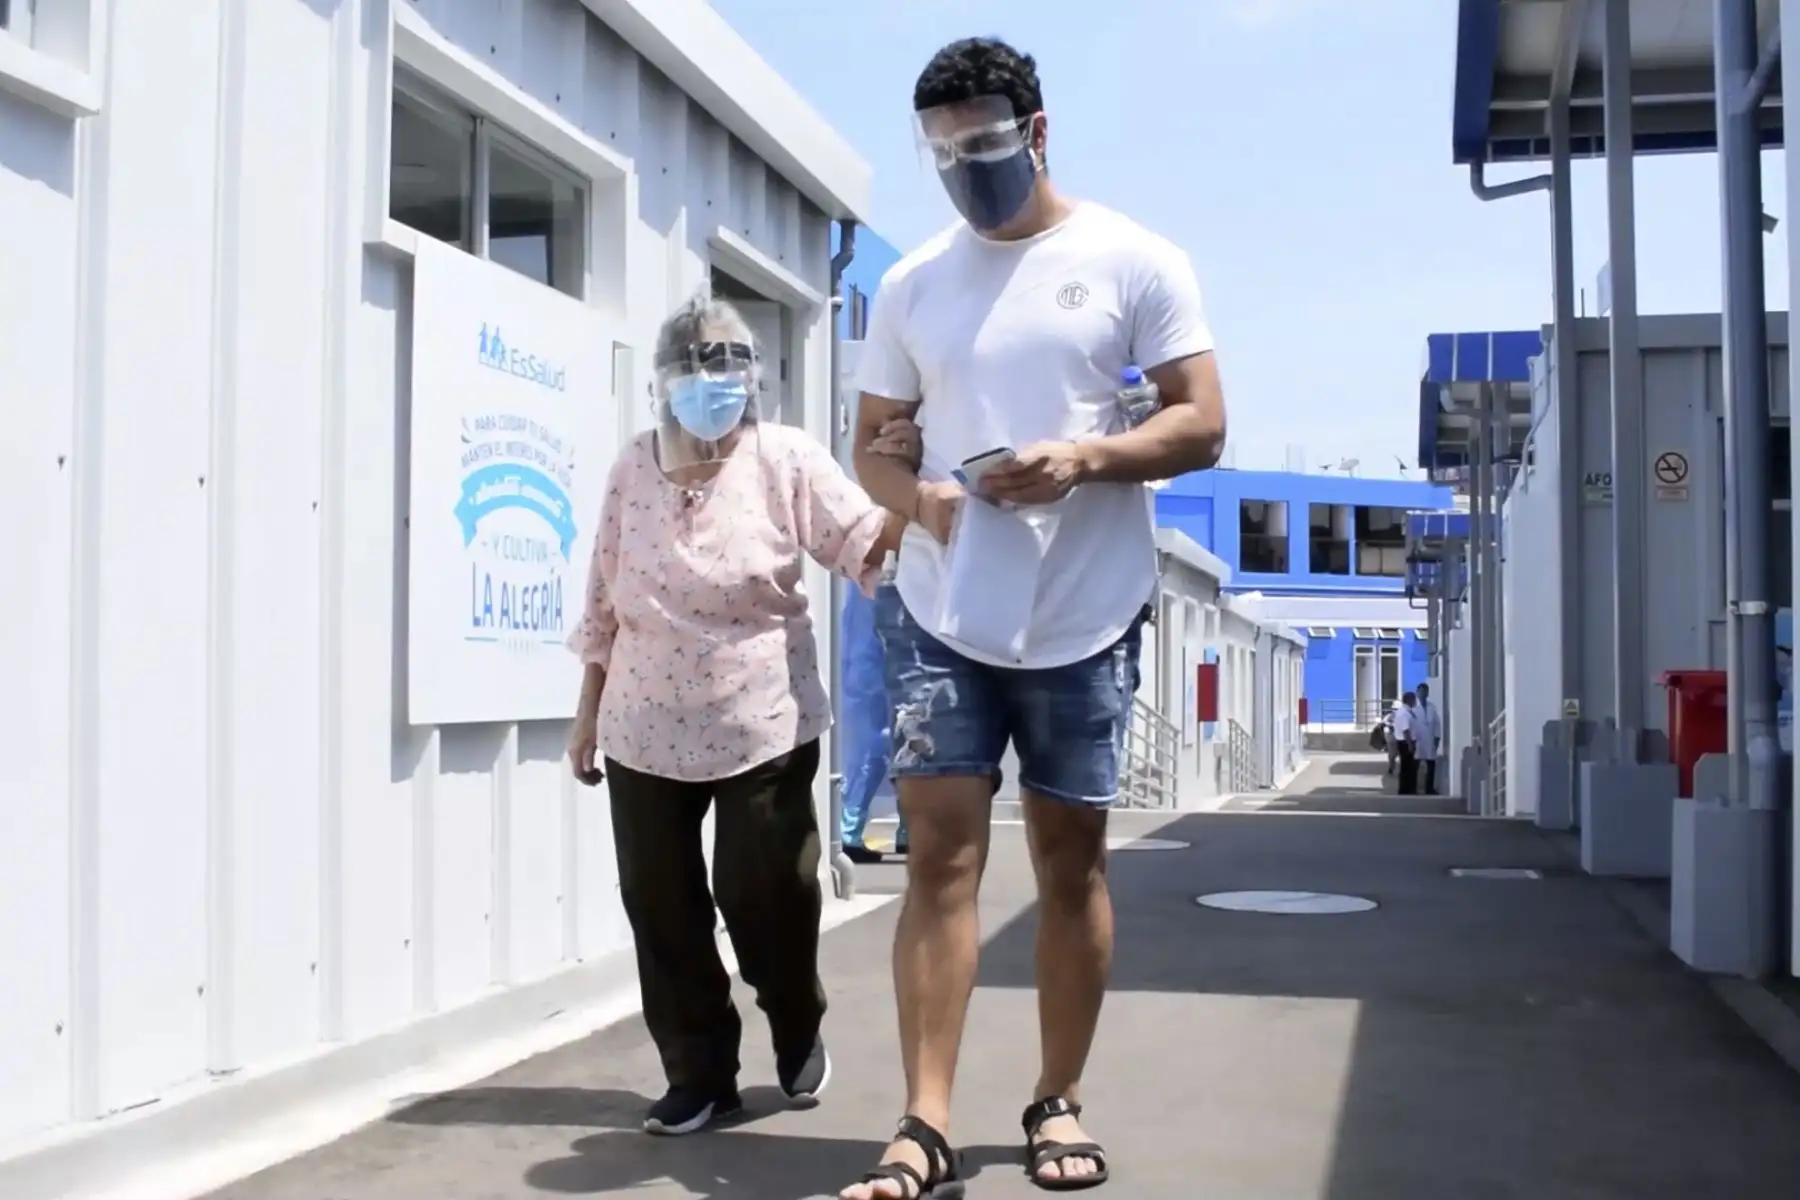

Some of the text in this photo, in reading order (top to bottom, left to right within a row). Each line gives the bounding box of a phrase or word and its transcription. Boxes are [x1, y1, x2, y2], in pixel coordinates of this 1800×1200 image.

[511, 348, 565, 391] EsSalud
[503, 534, 548, 562] CULTIVA
[472, 561, 563, 632] LA ALEGRÍA
